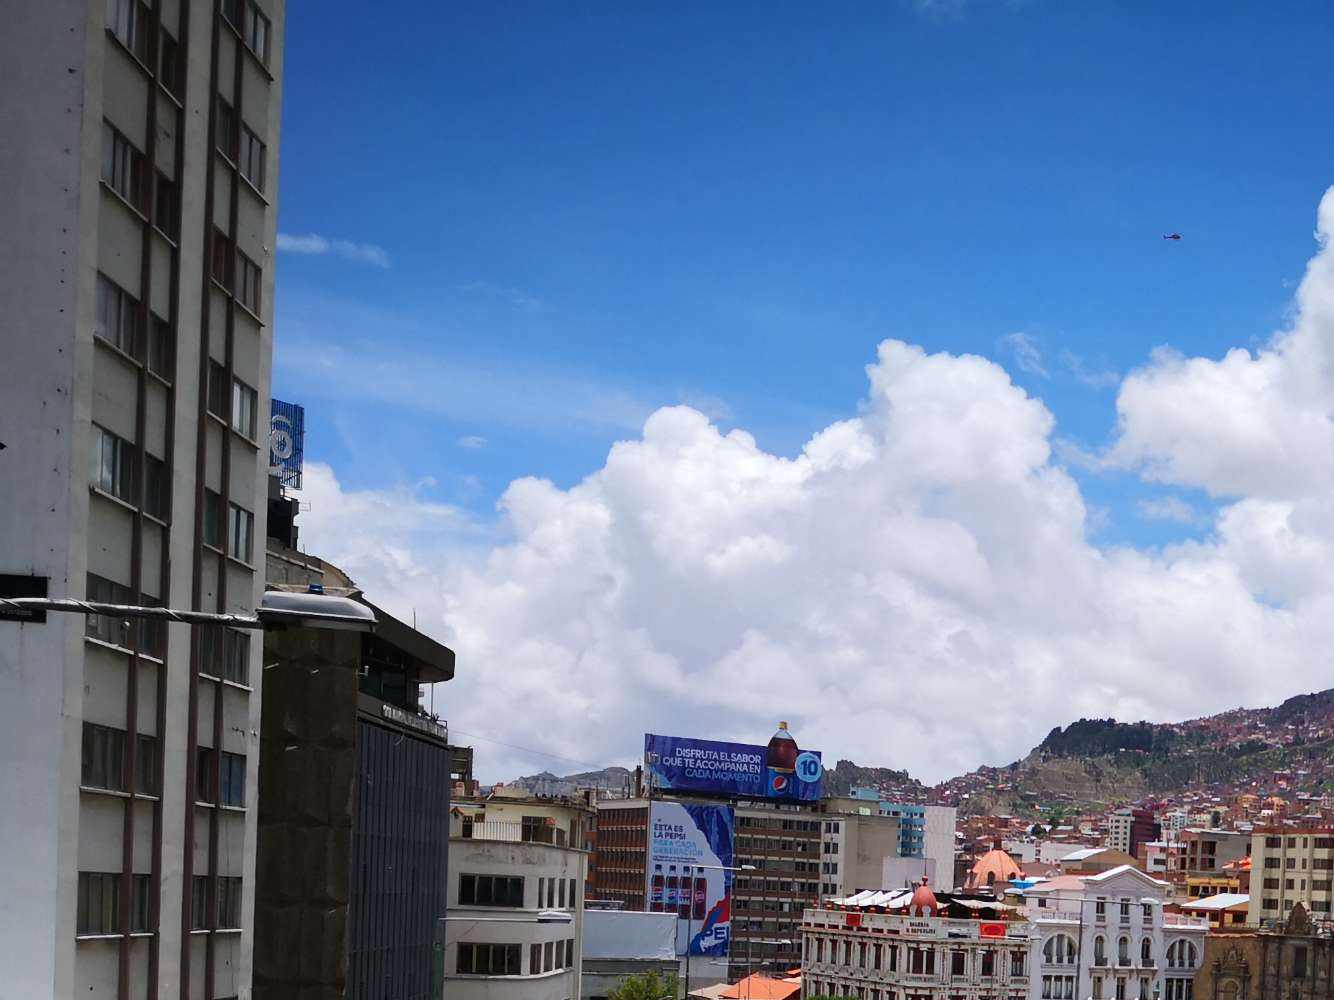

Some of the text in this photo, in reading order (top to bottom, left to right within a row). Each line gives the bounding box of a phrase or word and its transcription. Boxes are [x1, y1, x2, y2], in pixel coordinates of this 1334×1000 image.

[675, 747, 762, 764] DISFRUTA EL SABOR
[662, 756, 683, 767] QUE
[684, 758, 695, 768] TE
[749, 764, 761, 774] EN
[800, 761, 819, 776] 10
[685, 768, 760, 782] CADA MOMENTO
[653, 831, 686, 841] LA PEPSI
